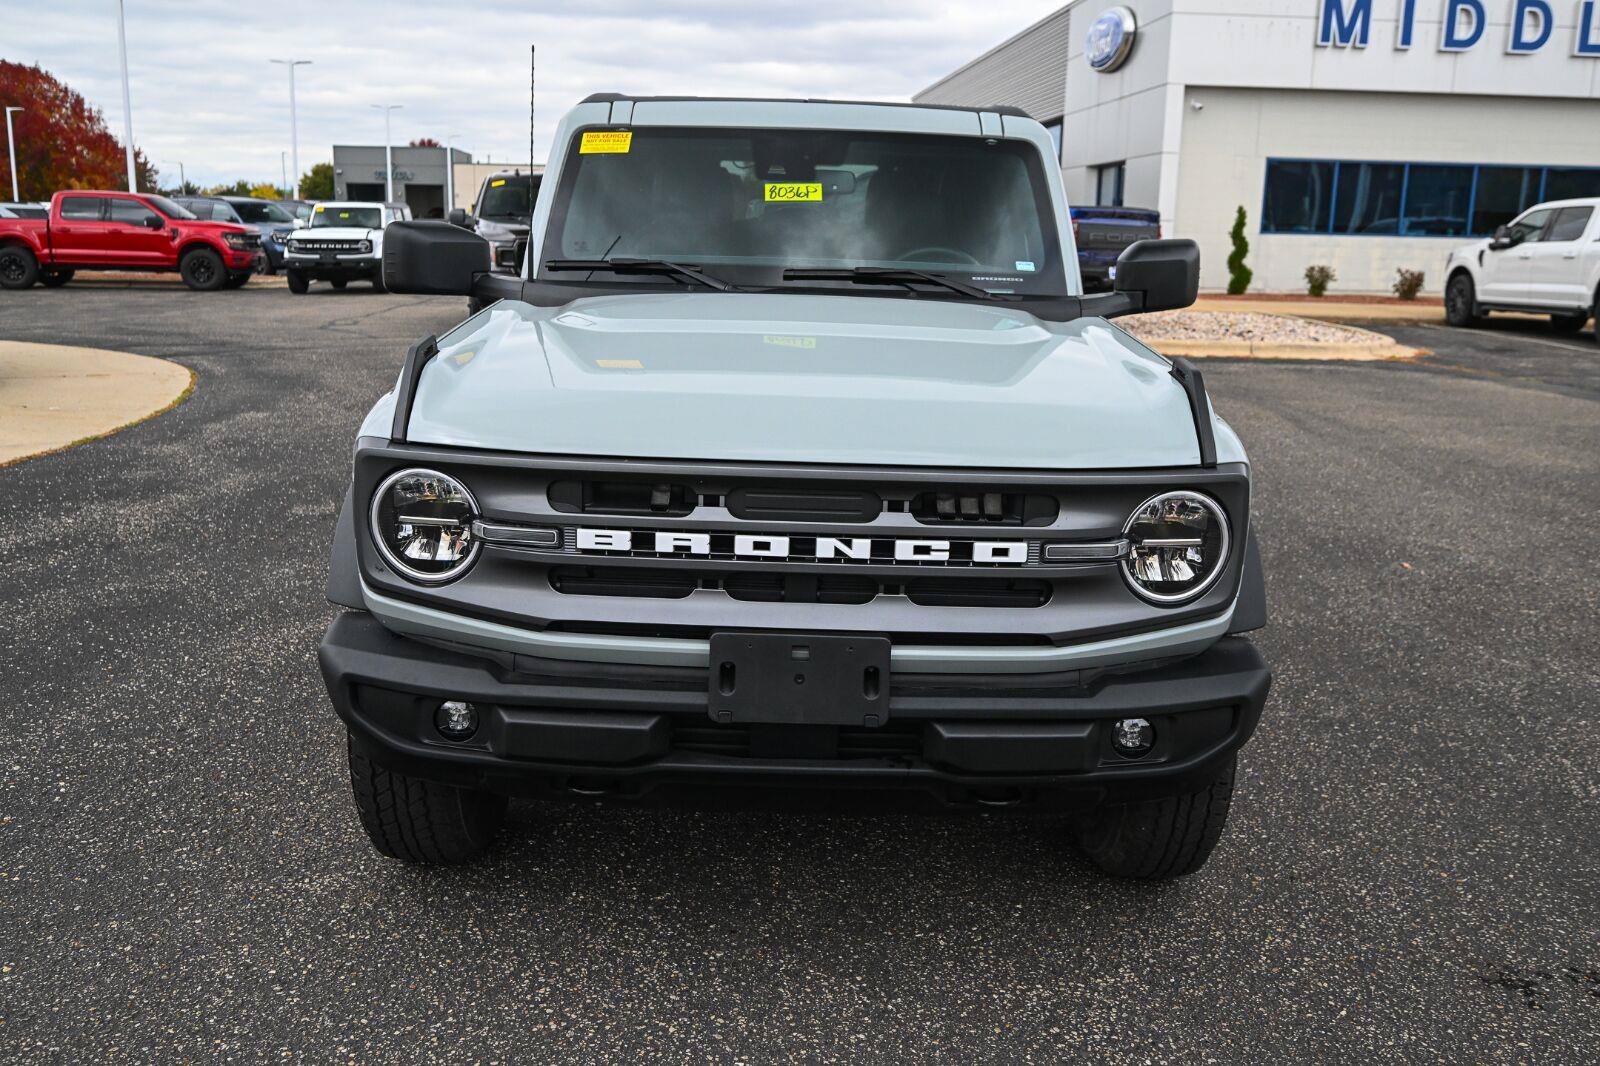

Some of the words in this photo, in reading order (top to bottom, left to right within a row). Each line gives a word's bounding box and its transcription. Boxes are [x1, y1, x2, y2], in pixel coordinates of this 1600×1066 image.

[1316, 0, 1600, 57] MIDDL
[1089, 231, 1152, 241] FORD
[576, 528, 1028, 563] BRONCO
